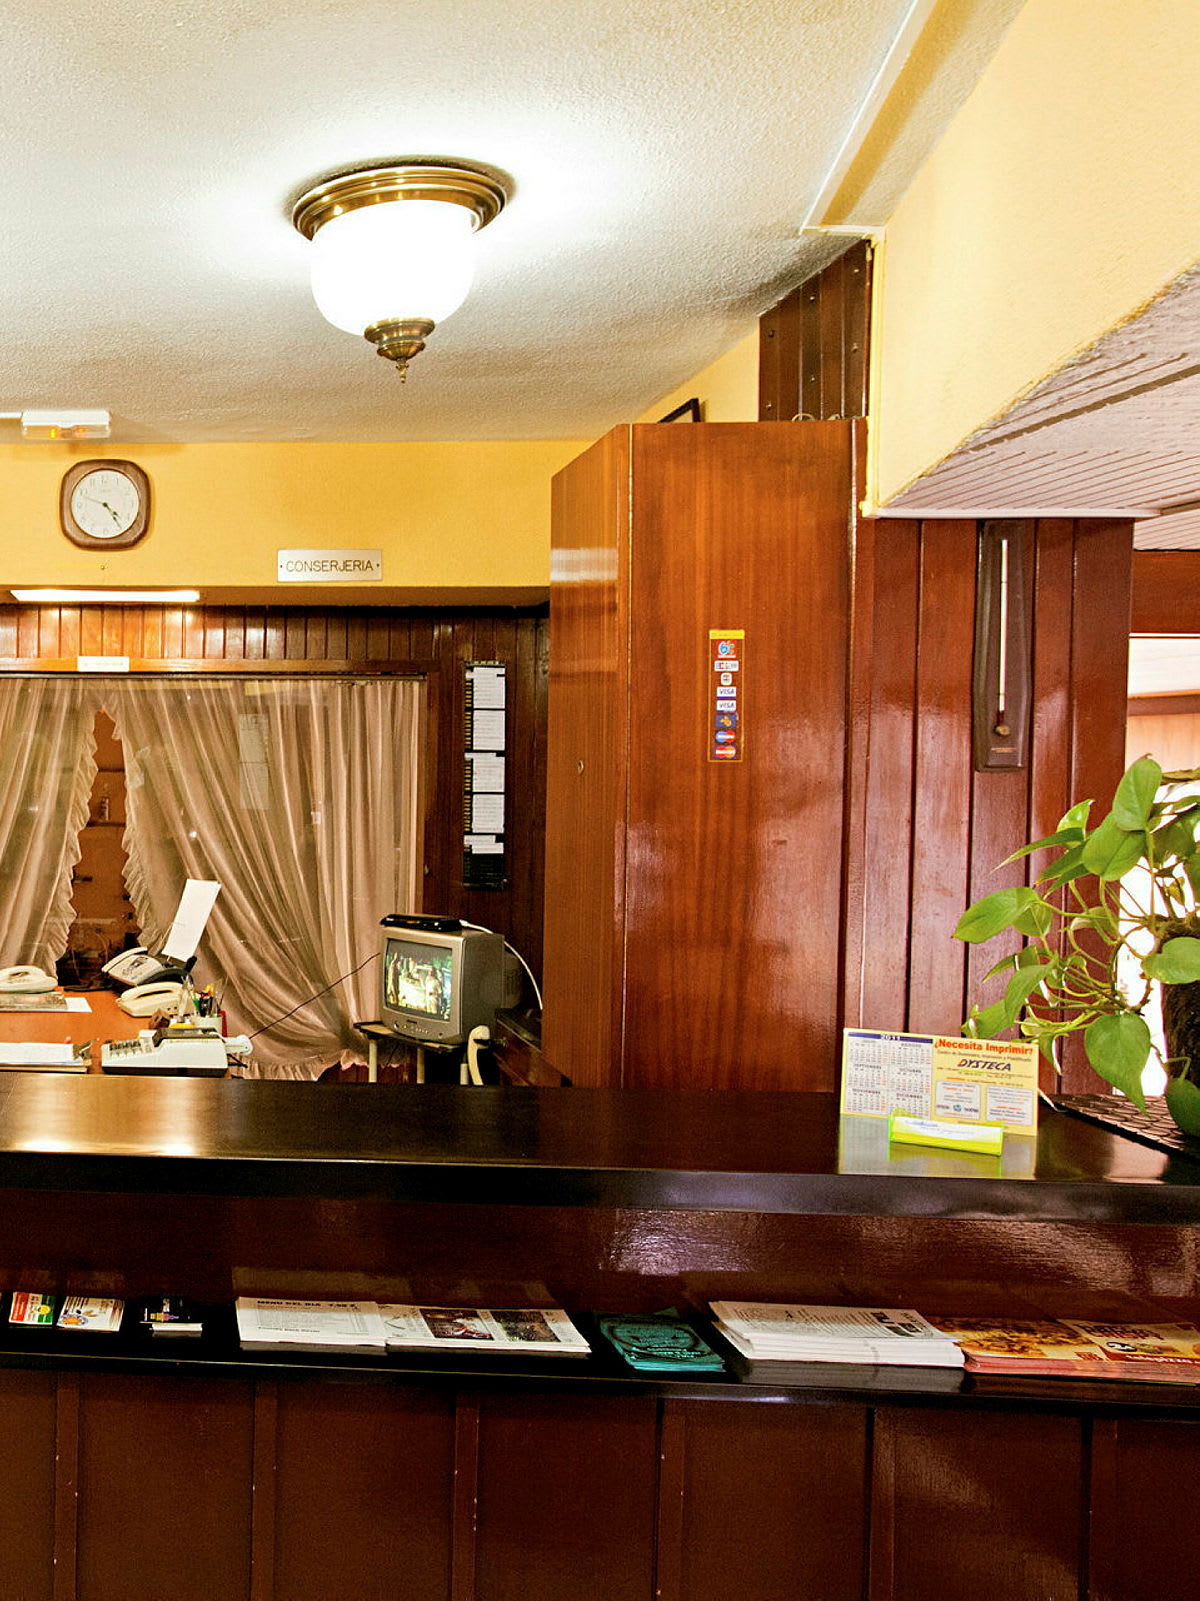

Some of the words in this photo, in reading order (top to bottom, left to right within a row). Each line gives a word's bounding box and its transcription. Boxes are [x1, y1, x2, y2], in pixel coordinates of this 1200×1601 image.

[286, 559, 373, 572] CONSERJERIA
[934, 1039, 983, 1051] ¿Necesita
[957, 1058, 1012, 1071] DYSTECA
